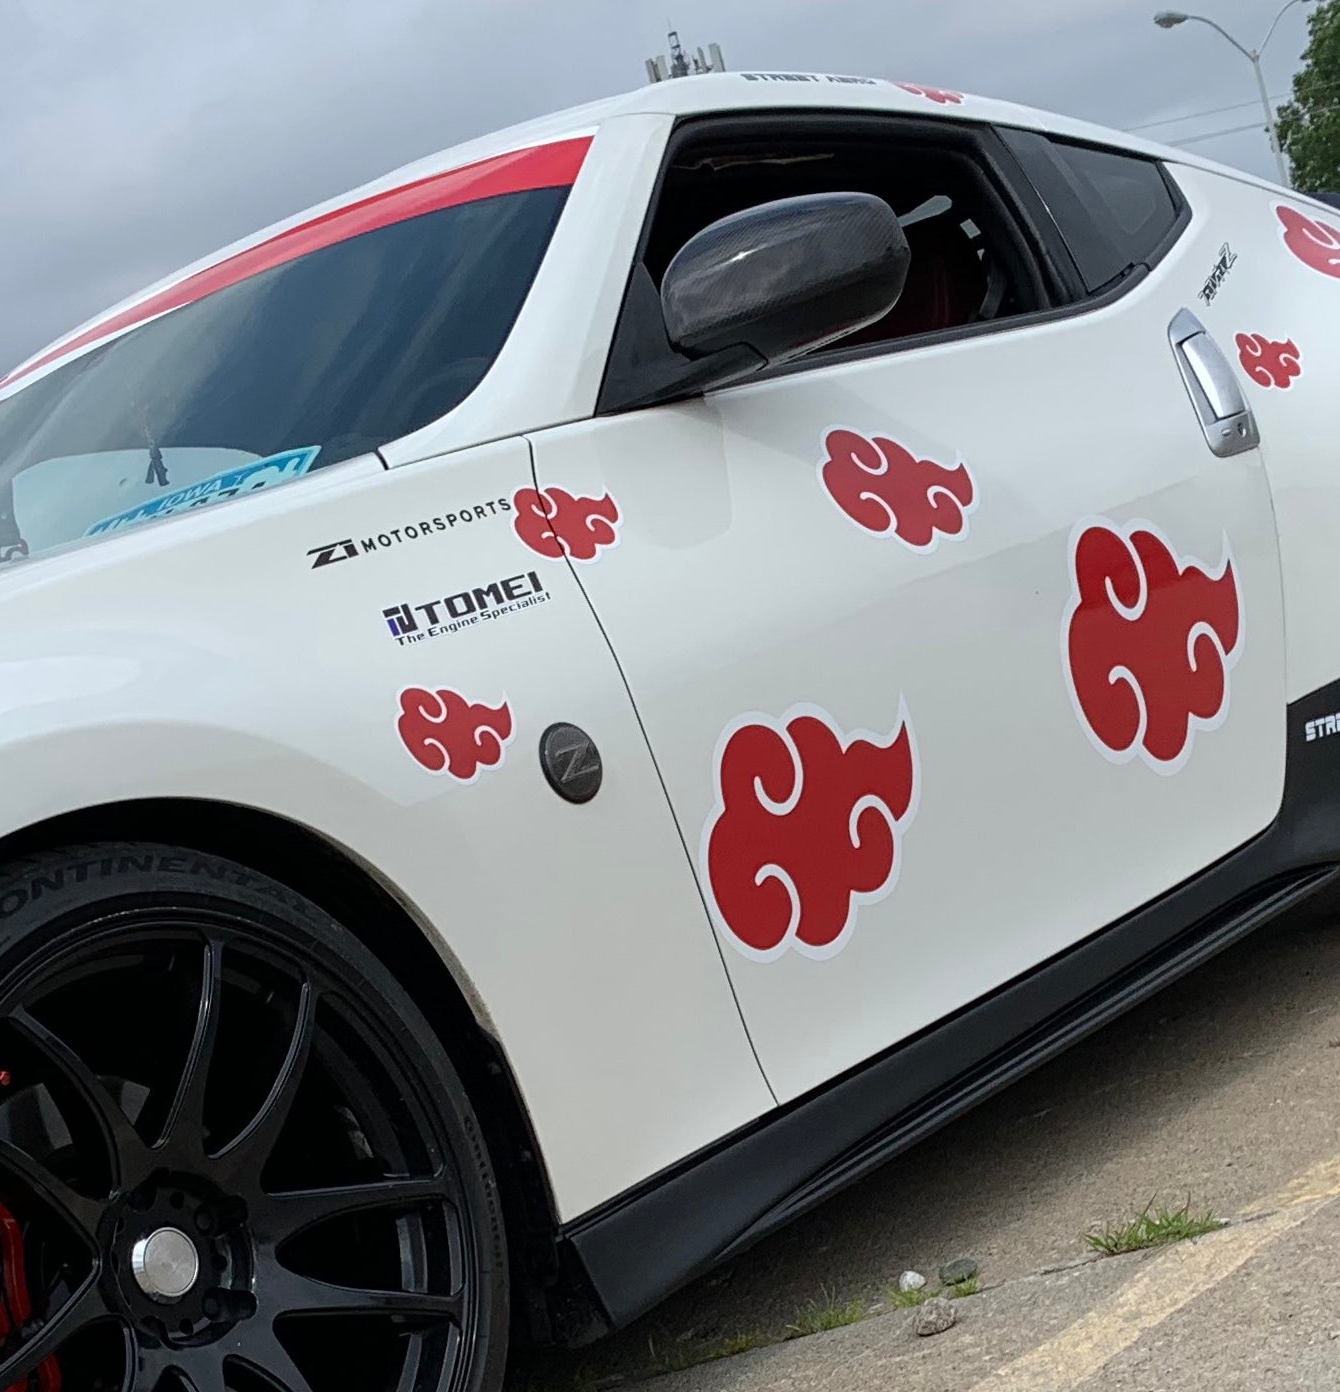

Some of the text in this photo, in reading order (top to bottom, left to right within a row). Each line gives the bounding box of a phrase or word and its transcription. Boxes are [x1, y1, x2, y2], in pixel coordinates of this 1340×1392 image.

[159, 480, 223, 508] IOWA
[361, 497, 512, 553] MOTORSPORTS
[395, 590, 552, 647] The Engine Specialist
[414, 571, 544, 626] TOMEI
